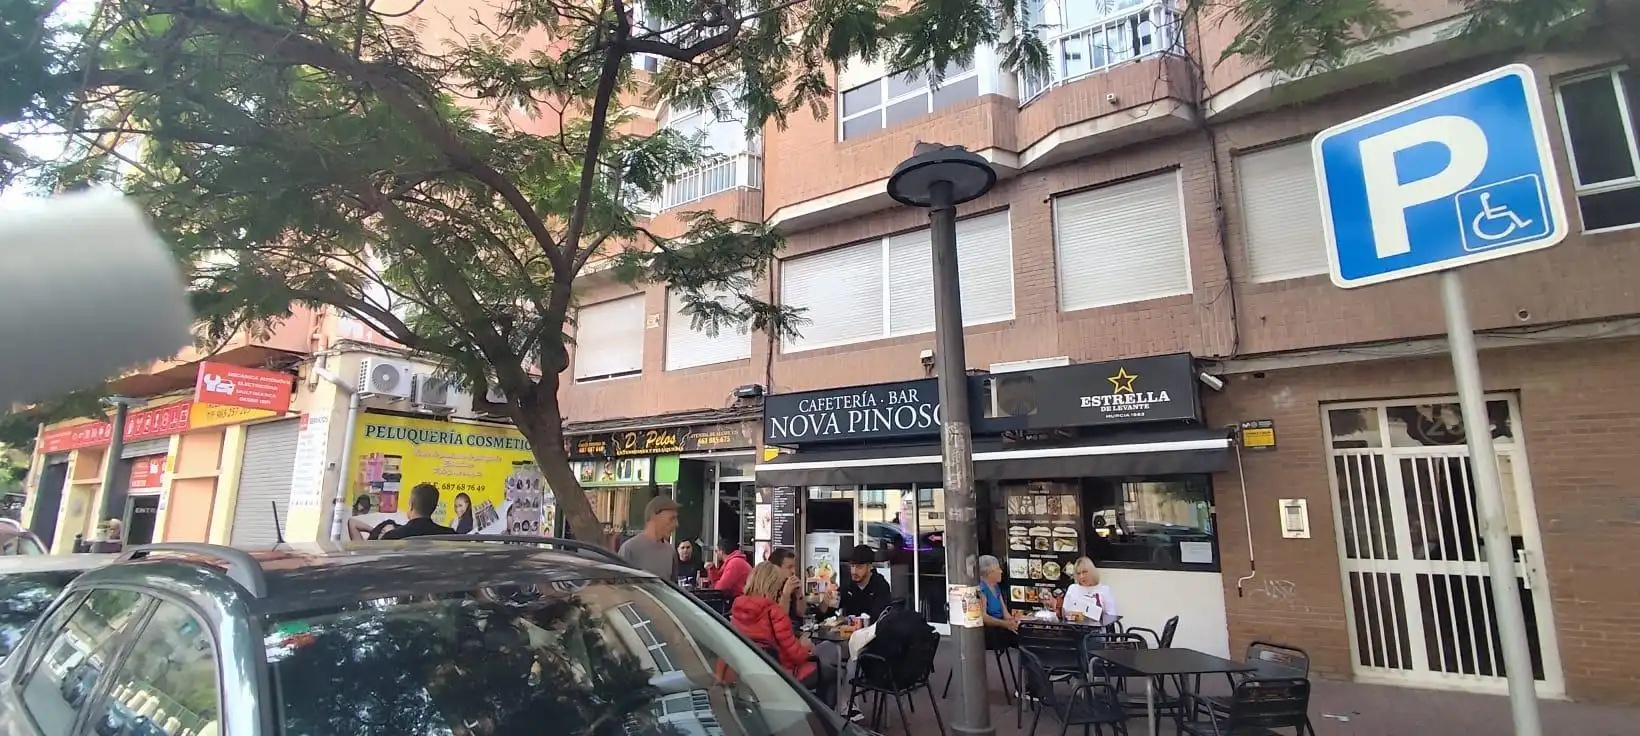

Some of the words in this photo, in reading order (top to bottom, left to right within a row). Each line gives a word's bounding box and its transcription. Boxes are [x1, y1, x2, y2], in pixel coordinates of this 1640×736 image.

[1359, 115, 1489, 259] P
[799, 390, 877, 413] CAFETERÍA
[889, 388, 919, 405] BAR
[1080, 390, 1171, 408] ESTRELLA
[1113, 403, 1150, 412] LEVANTE
[365, 424, 463, 445] PELUQUERÍA
[770, 411, 841, 439] NOVA
[645, 430, 677, 449] Pelos
[441, 482, 455, 491] 687
